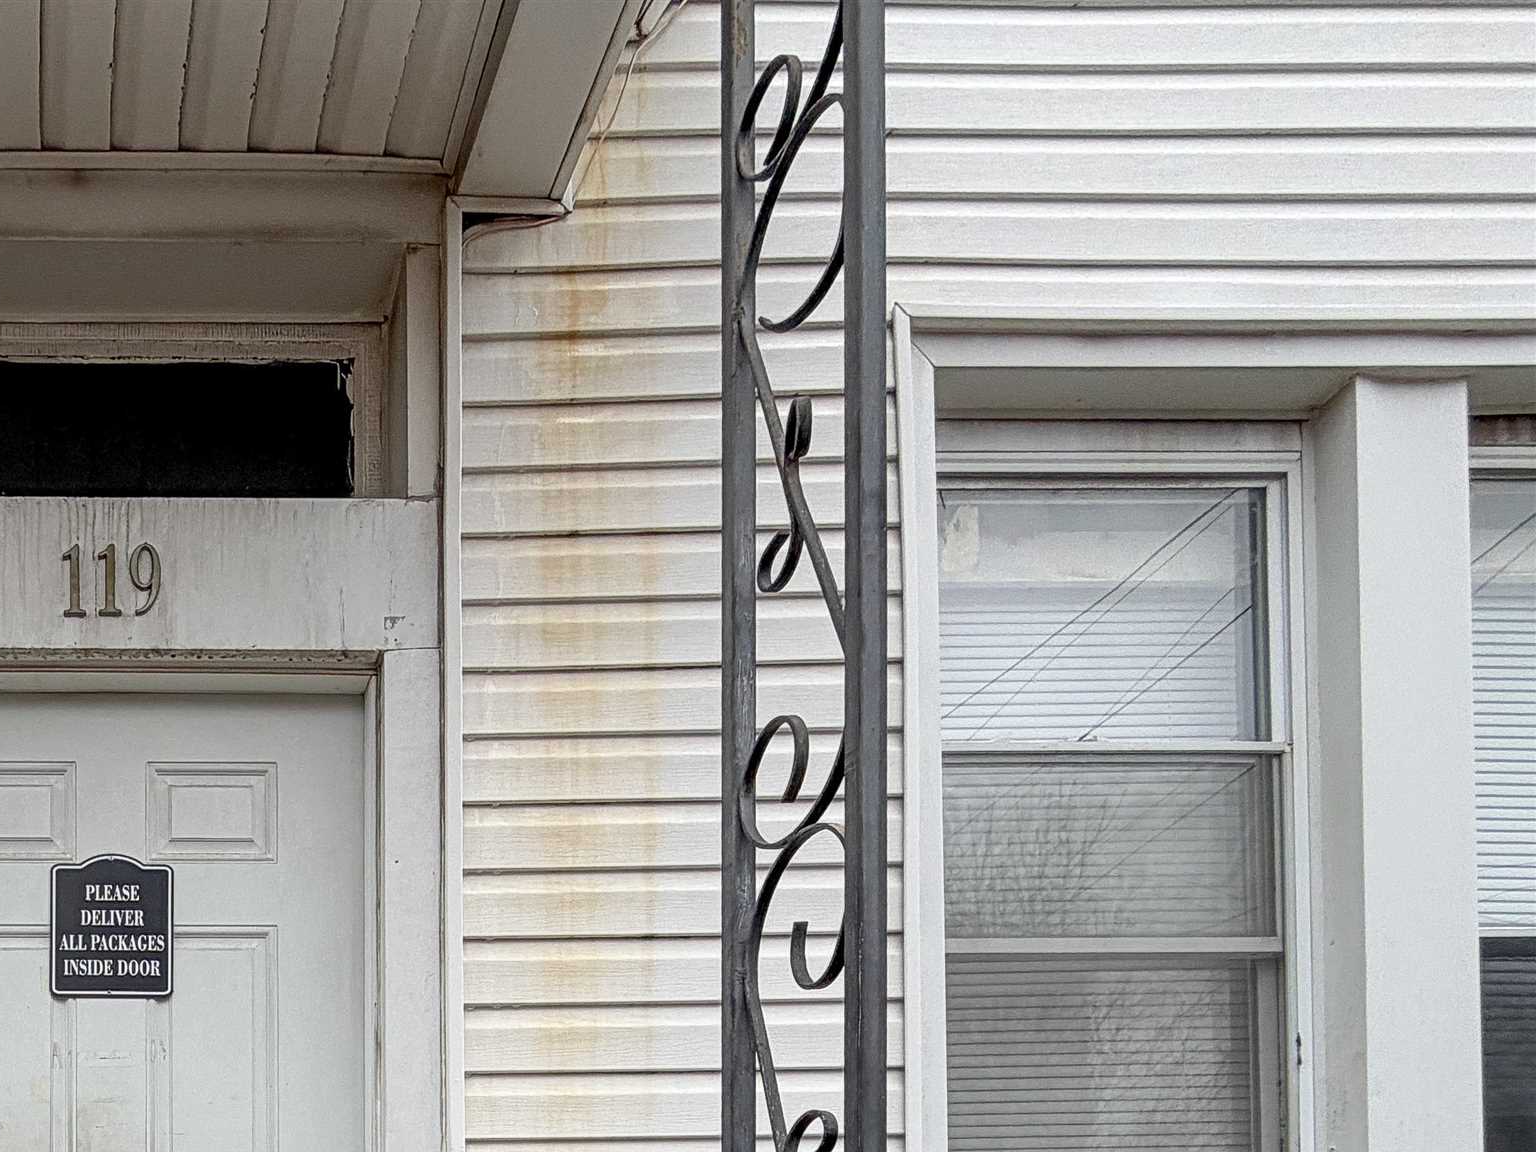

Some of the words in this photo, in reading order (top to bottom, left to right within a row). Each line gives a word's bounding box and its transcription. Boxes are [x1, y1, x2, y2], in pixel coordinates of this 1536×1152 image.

[62, 542, 161, 618] 119
[85, 884, 140, 902] PLEASE
[80, 909, 145, 927] DELIVER
[59, 934, 87, 951] ALL
[91, 934, 165, 952] PACKAGES
[63, 959, 114, 976] INSIDE
[117, 959, 161, 977] DOOR
